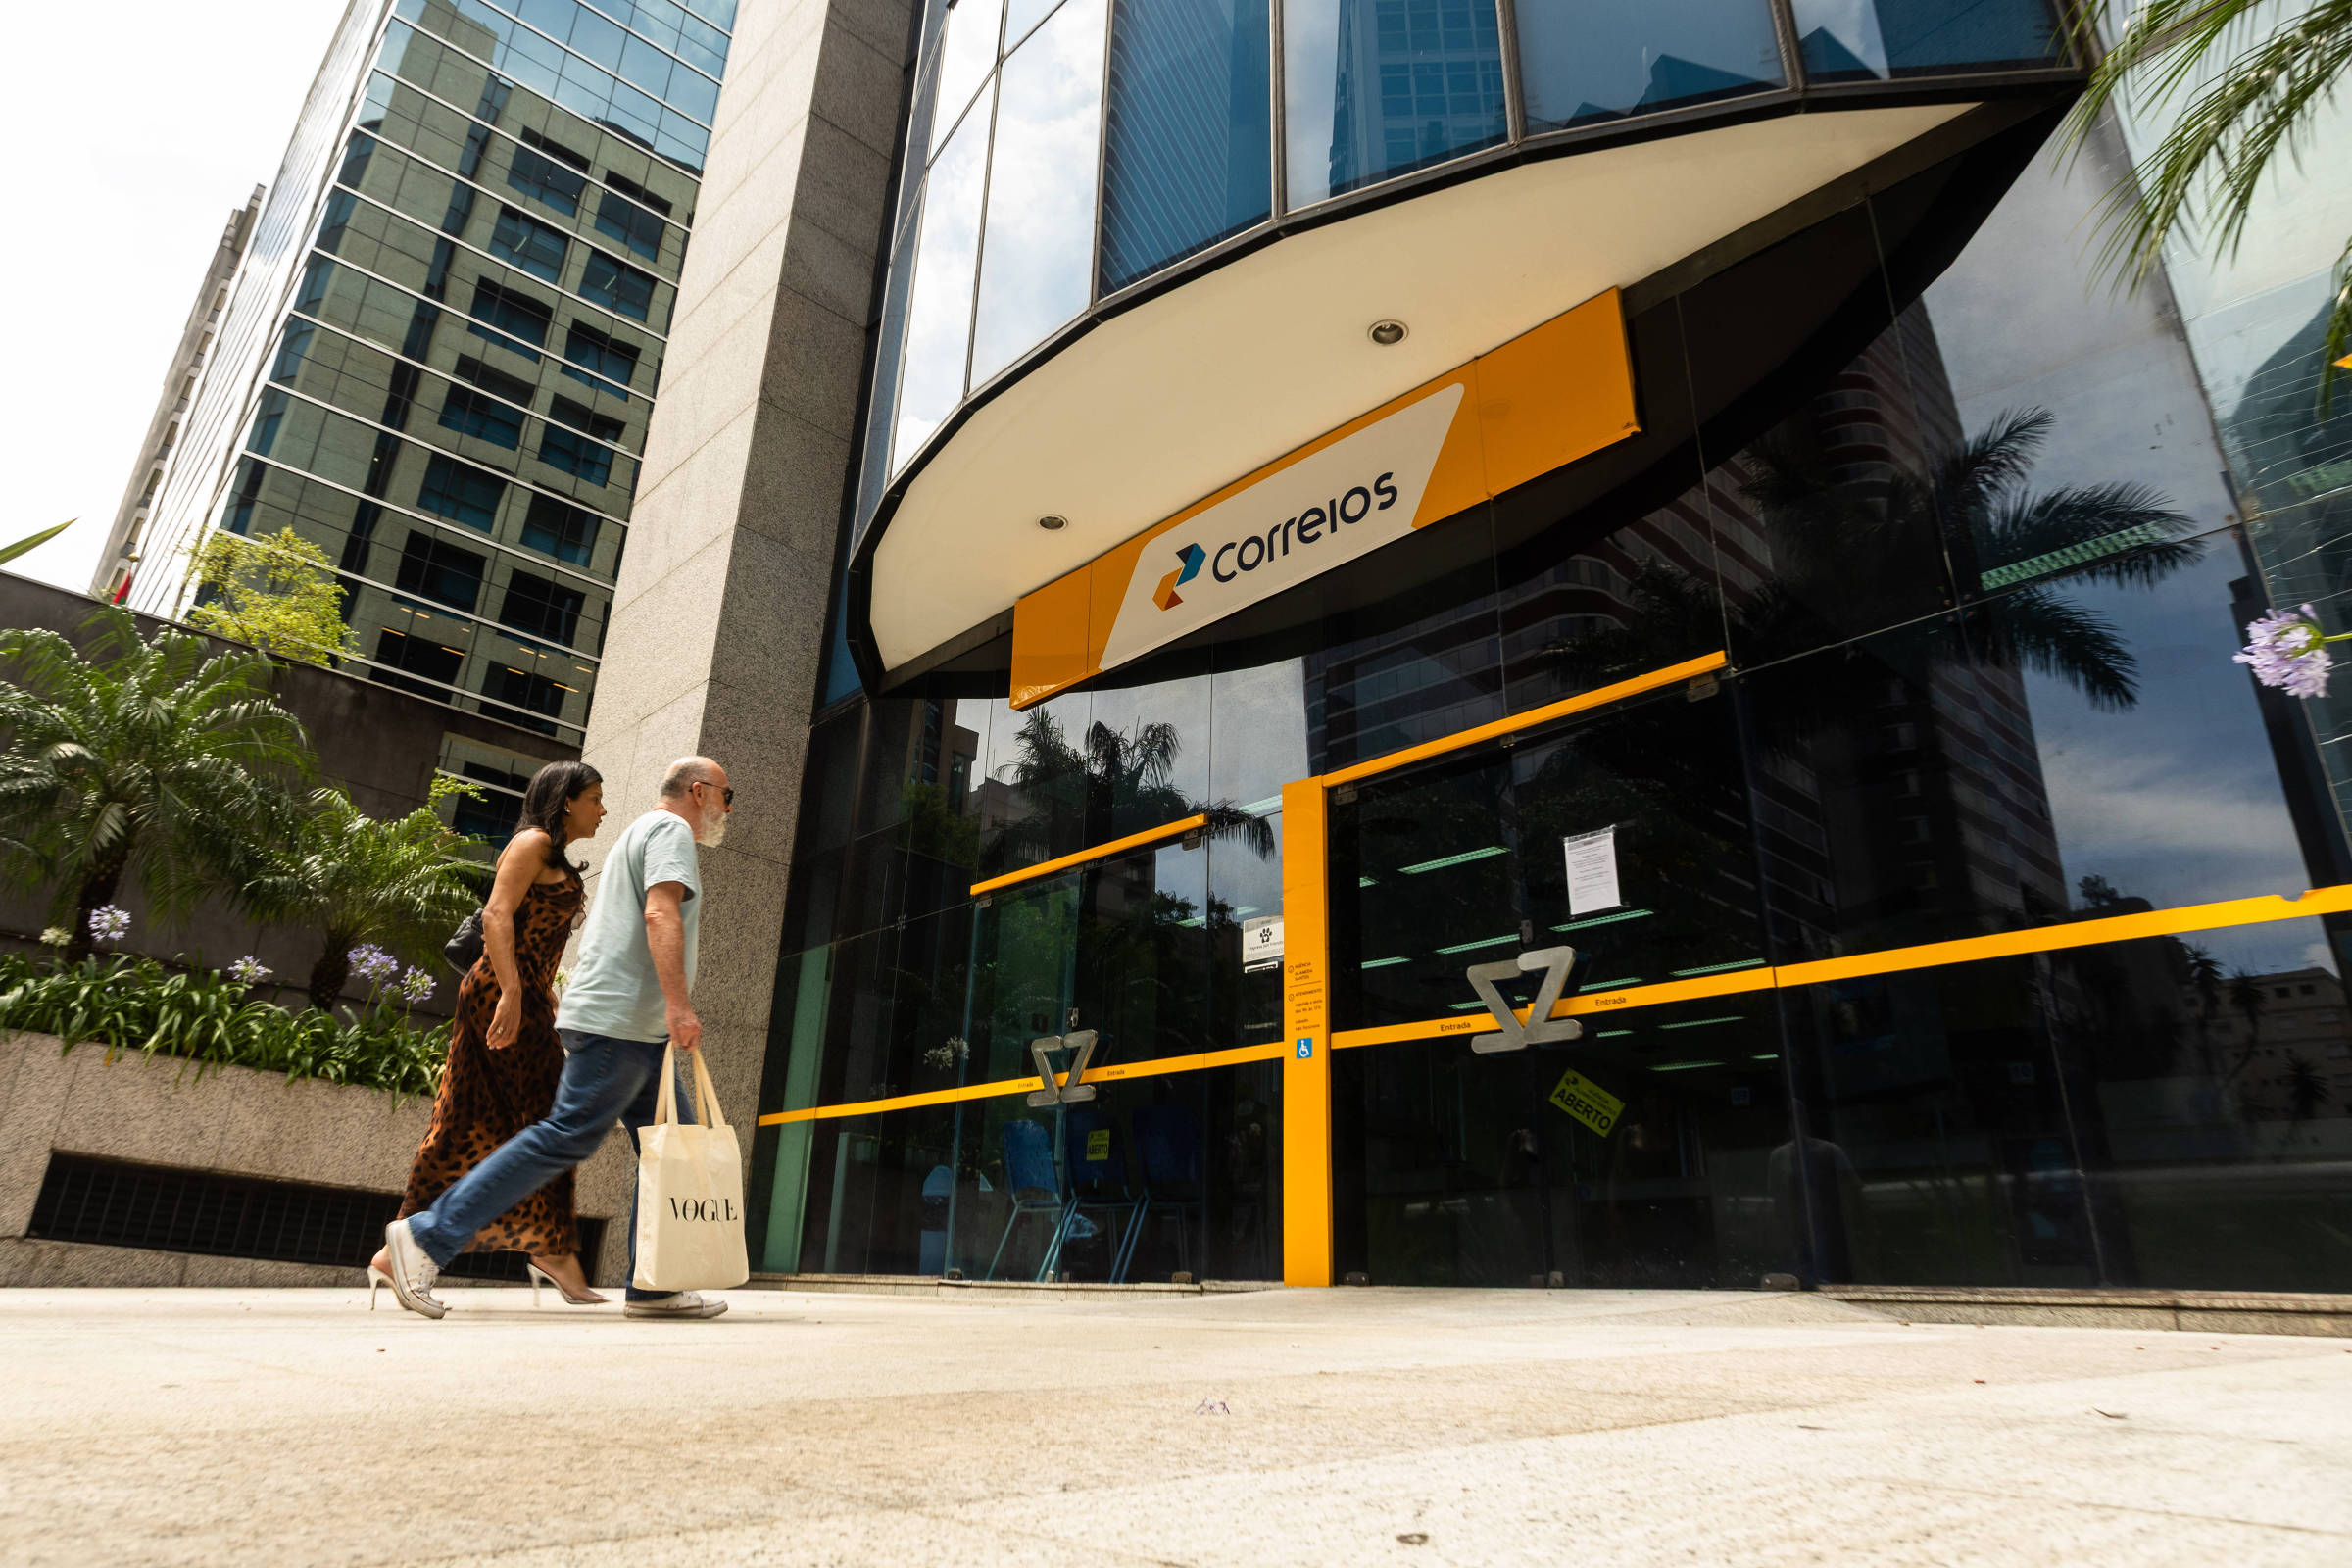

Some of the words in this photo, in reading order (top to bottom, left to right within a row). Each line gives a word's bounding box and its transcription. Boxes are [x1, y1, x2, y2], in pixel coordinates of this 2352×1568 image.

[1595, 996, 1627, 1007] Entrada
[1440, 1021, 1471, 1032] Entrada
[1554, 1088, 1611, 1130] ABERTO
[1088, 1144, 1108, 1155] ABERTO
[668, 1197, 738, 1222] VOGUE
